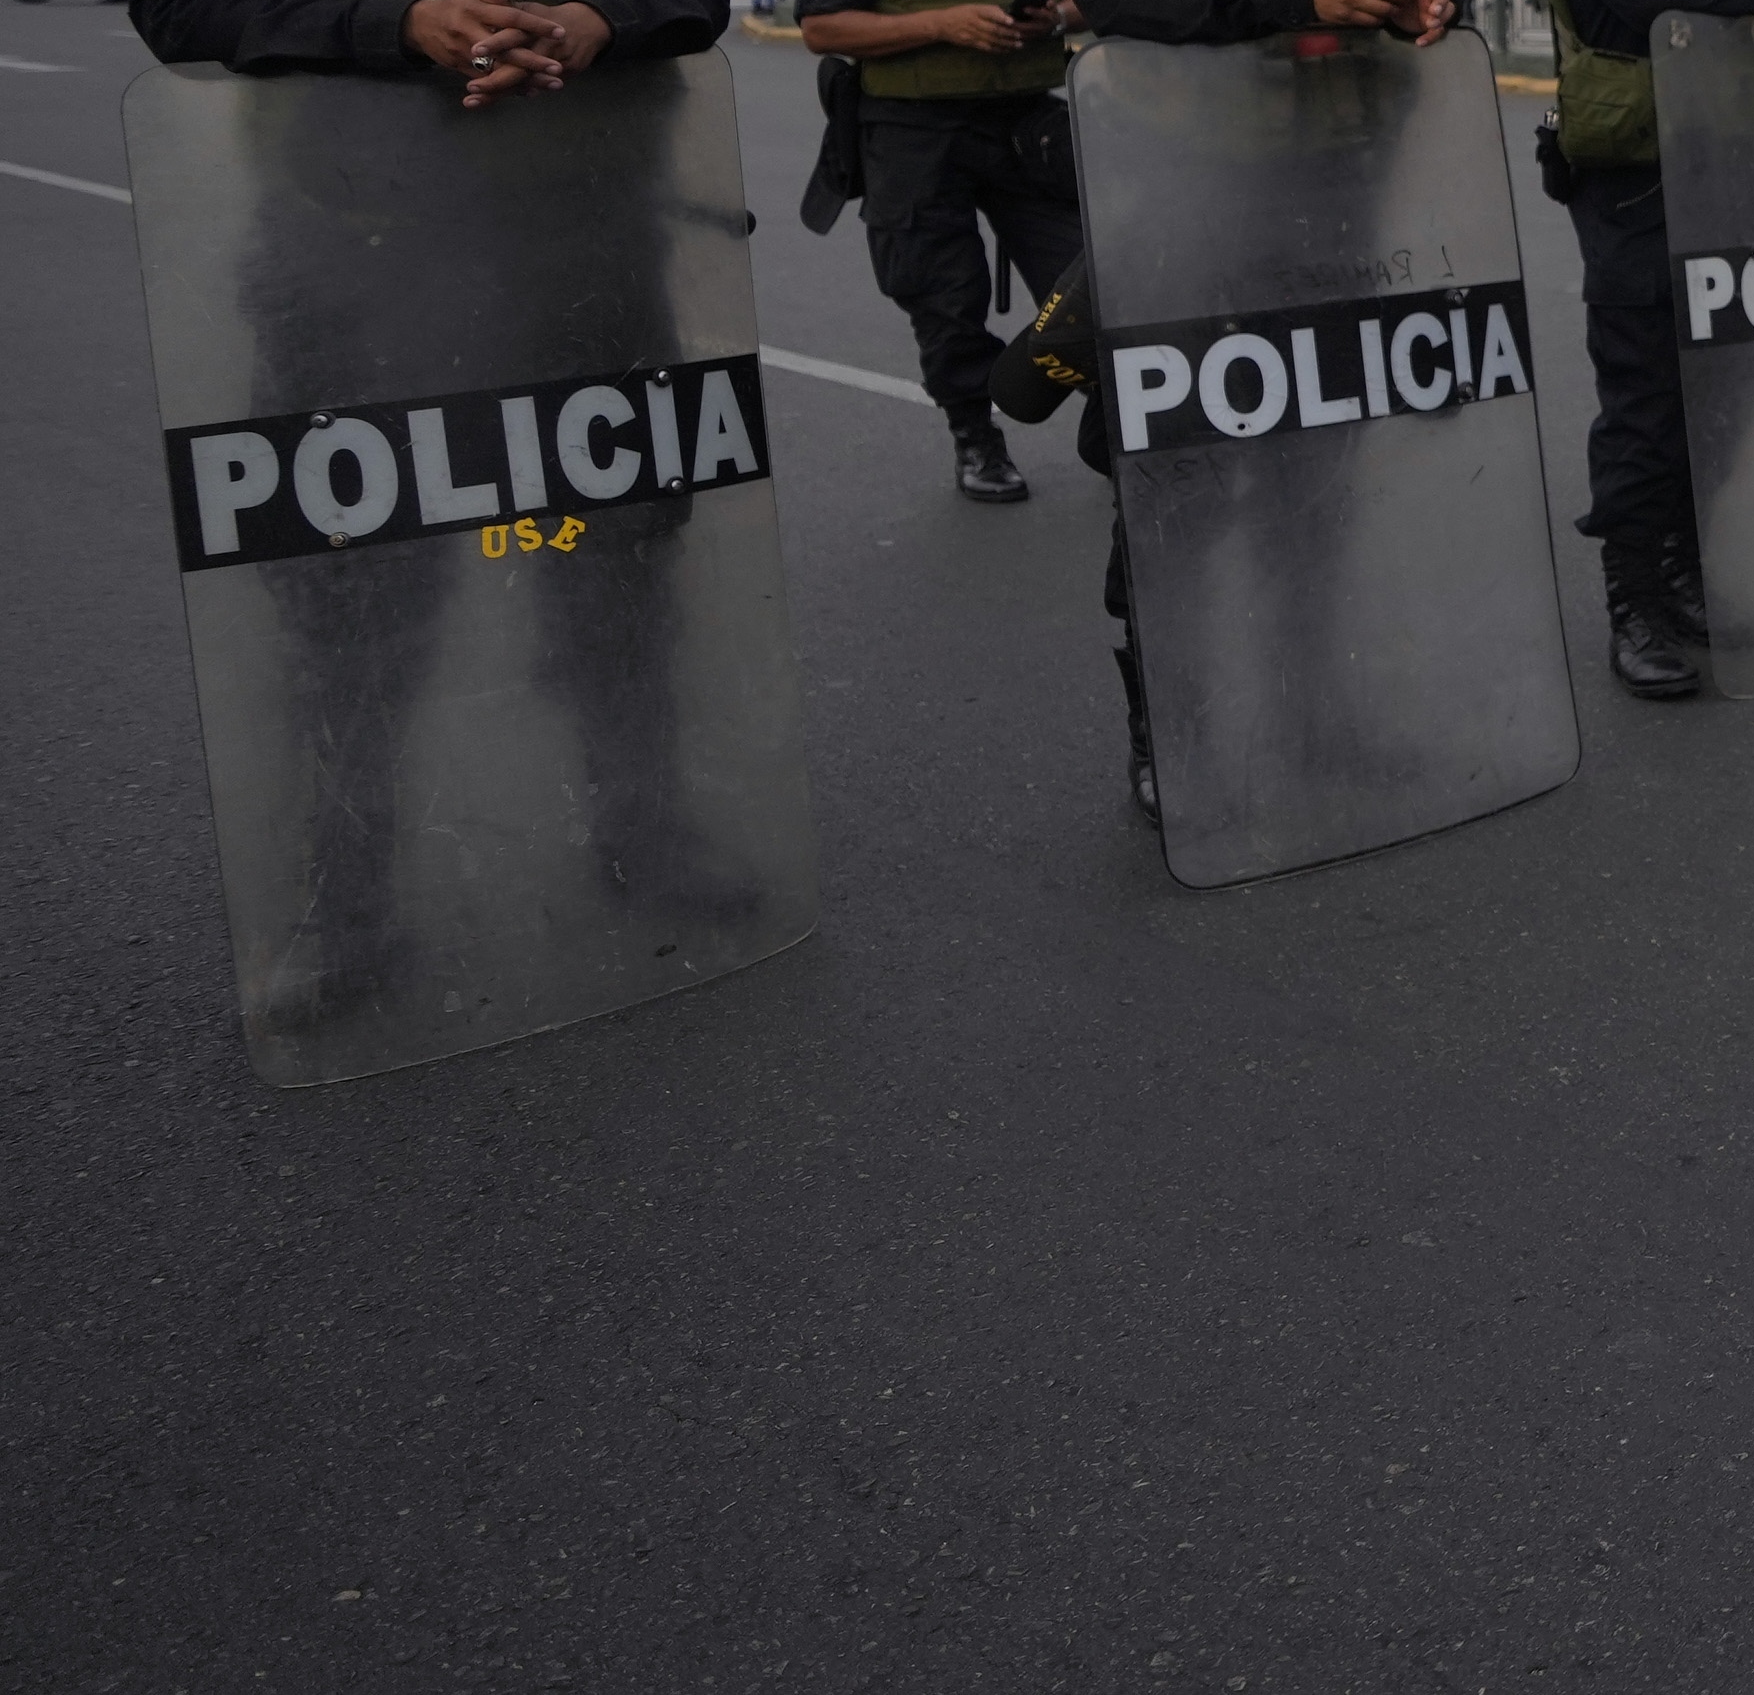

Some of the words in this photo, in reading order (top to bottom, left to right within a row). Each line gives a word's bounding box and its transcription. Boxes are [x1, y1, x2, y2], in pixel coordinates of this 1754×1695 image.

[1112, 304, 1530, 453] POLICIA
[189, 369, 760, 556] POLICIA
[480, 515, 587, 559] USE
